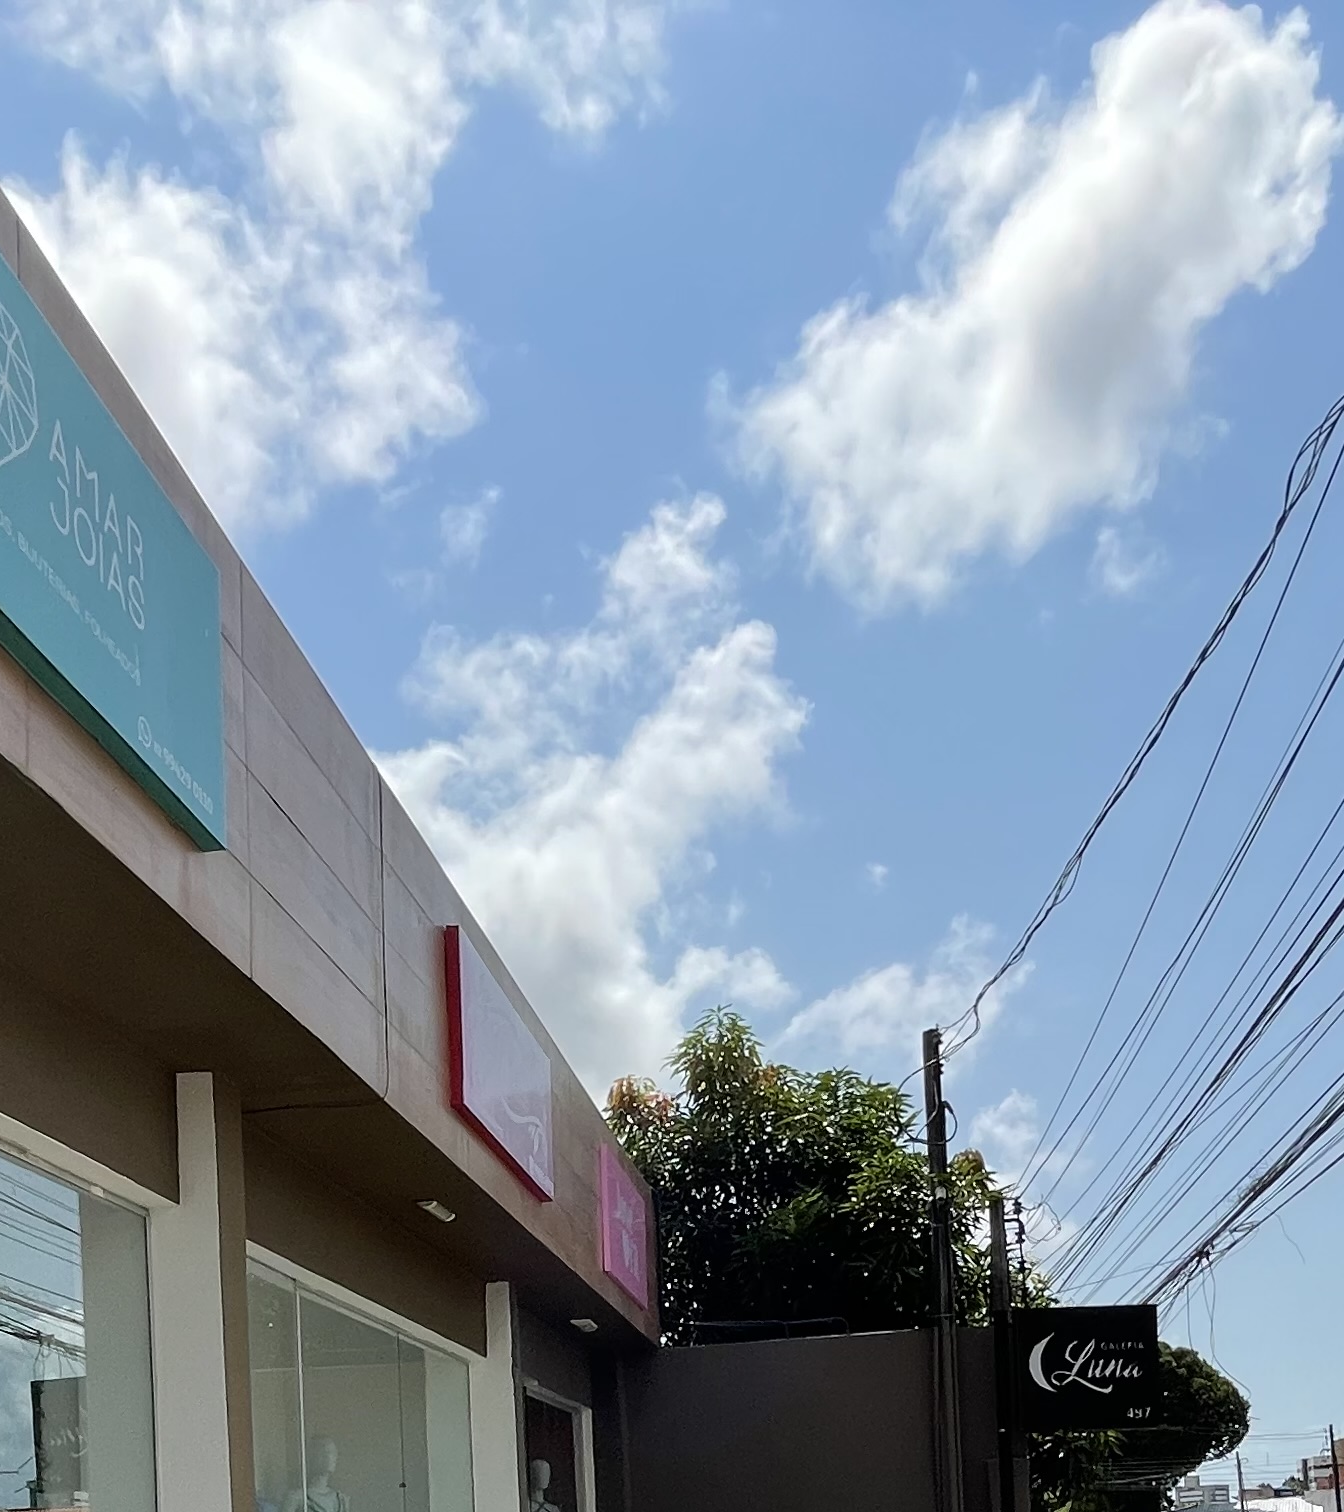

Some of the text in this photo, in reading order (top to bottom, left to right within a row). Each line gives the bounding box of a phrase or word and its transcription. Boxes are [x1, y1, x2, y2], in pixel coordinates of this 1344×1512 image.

[49, 418, 144, 581] AMAR
[50, 477, 146, 631] JOIAS
[1050, 1338, 1143, 1394] Luna
[1100, 1341, 1145, 1351] GALERIA
